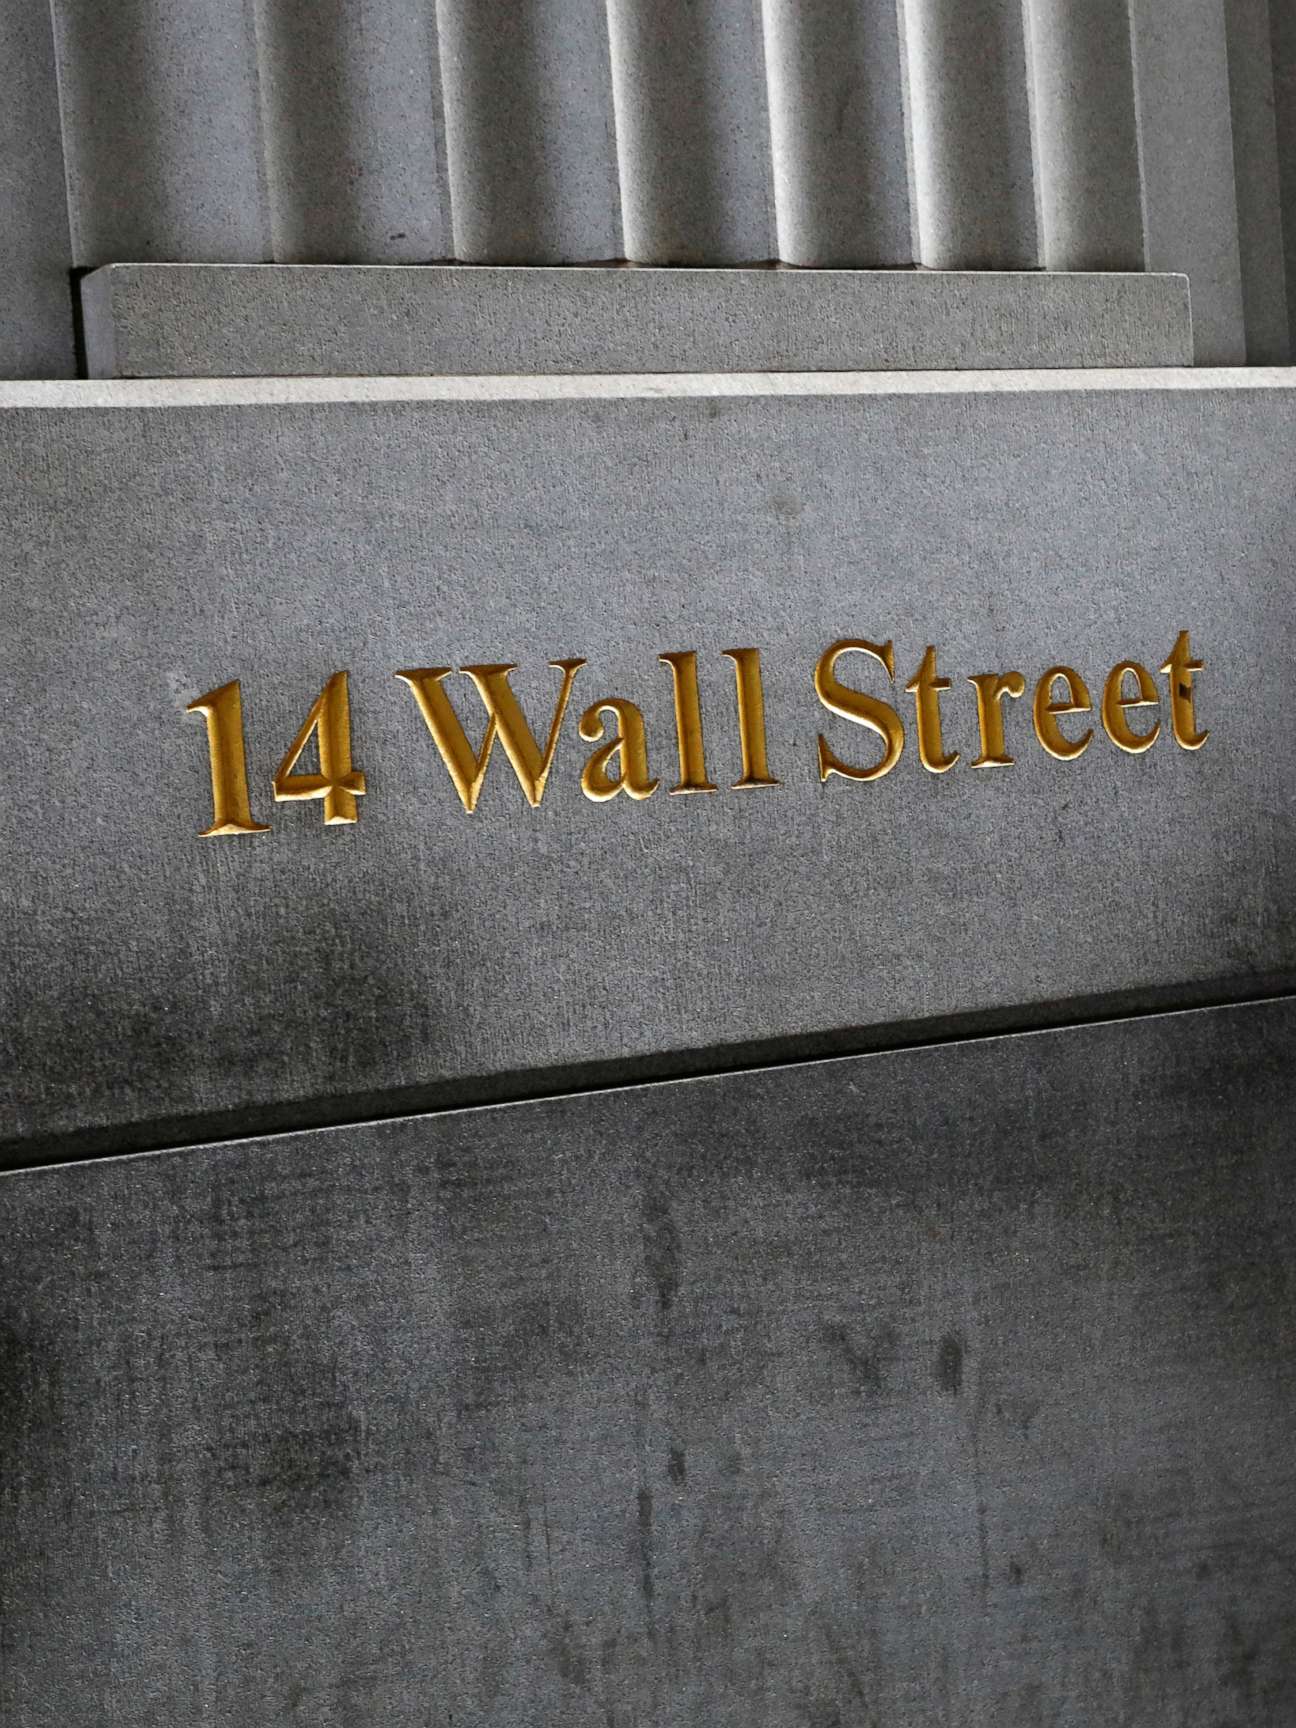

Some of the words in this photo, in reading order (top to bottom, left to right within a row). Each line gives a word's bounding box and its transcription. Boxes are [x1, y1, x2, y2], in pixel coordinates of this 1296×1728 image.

[186, 670, 366, 837] 14
[394, 647, 782, 814] Wall
[814, 630, 1209, 783] Street
